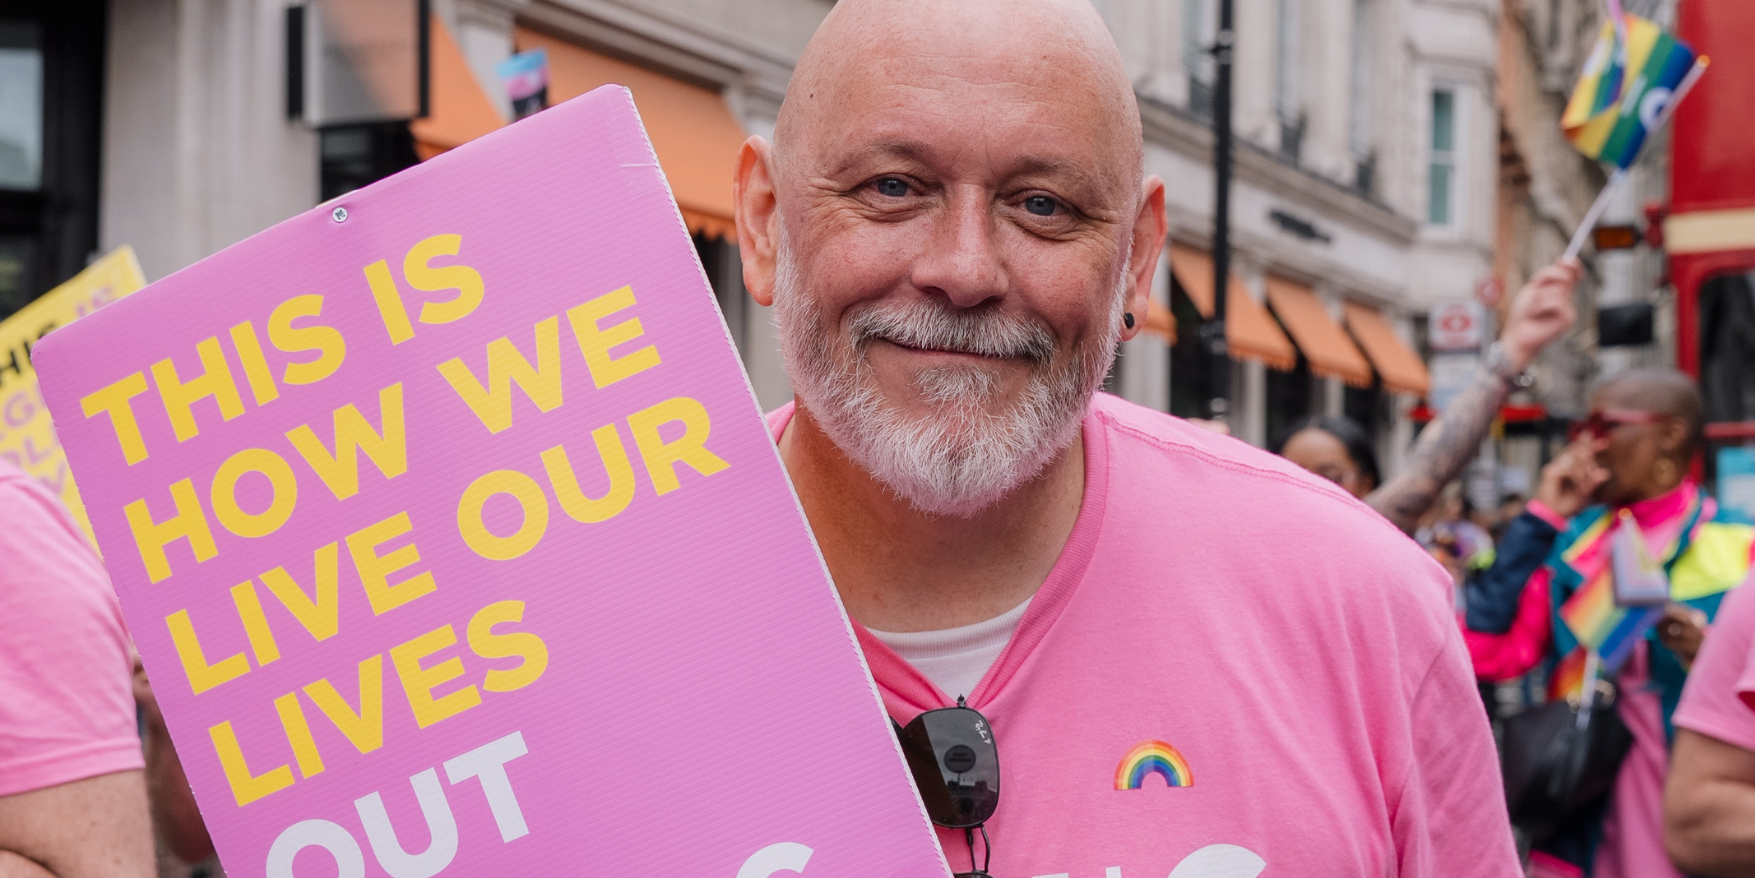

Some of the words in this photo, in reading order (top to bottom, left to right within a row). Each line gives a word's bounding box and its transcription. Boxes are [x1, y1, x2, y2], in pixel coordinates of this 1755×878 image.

[80, 293, 346, 466] THIS
[363, 233, 485, 346] IS
[123, 381, 408, 584] HOW
[436, 284, 662, 434] WE
[165, 510, 438, 695] LIVE
[456, 396, 731, 561] OUR
[208, 599, 549, 807] LIVES
[266, 730, 530, 878] OUT
